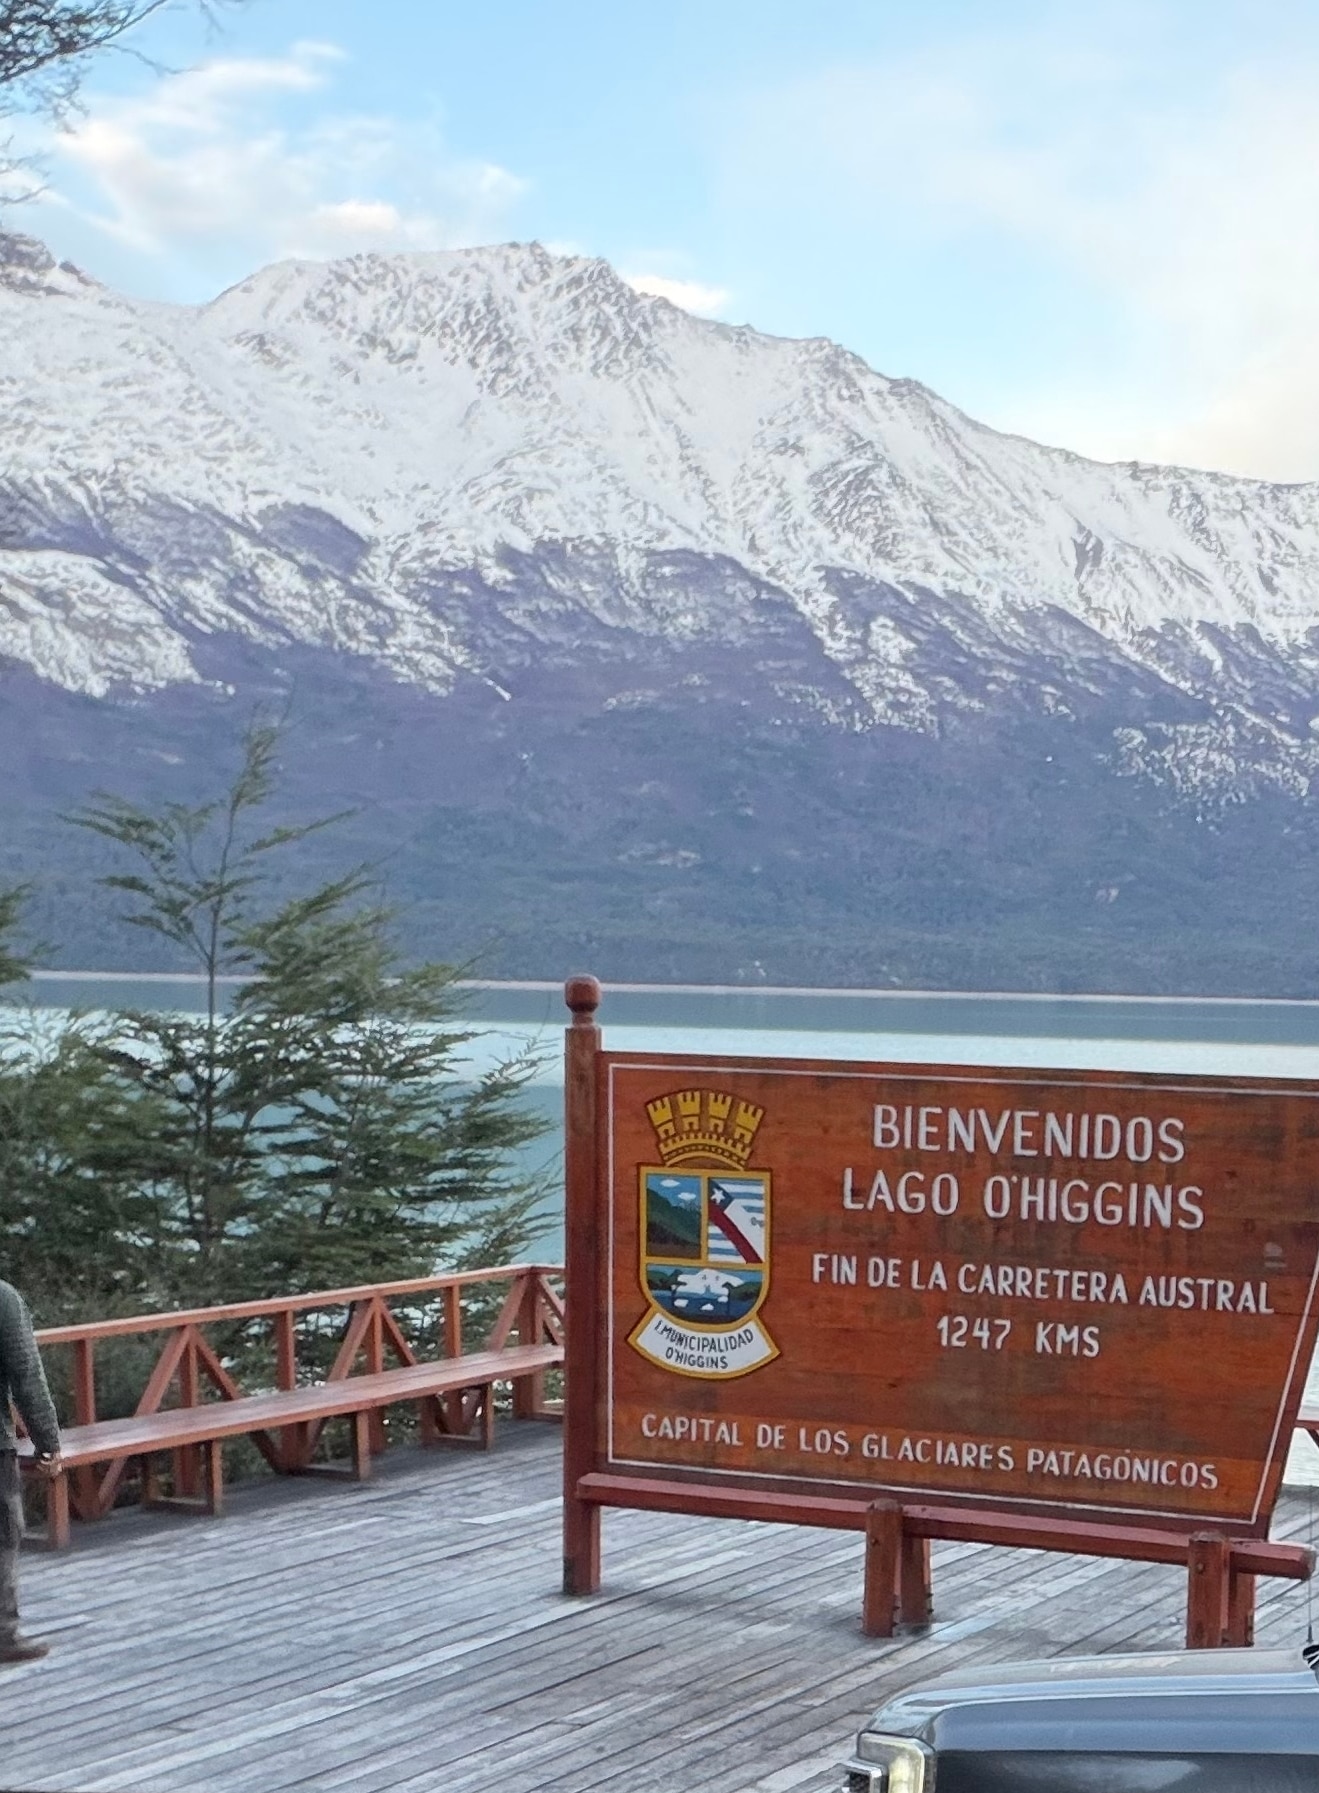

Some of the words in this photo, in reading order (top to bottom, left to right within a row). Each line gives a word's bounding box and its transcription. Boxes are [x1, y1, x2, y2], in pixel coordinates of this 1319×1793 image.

[872, 1103, 1186, 1164] BIENVENIDOS
[842, 1167, 959, 1217] LAGO
[983, 1174, 1205, 1230] O'HIGGINS
[812, 1253, 858, 1286] FIN
[867, 1257, 902, 1289] DE
[911, 1260, 948, 1292] LA
[957, 1263, 1129, 1305] CARRETERA
[1138, 1275, 1276, 1315] AUSTRAL
[665, 1347, 729, 1370] O'HIGGINS
[936, 1314, 1012, 1351] 1247
[1034, 1321, 1100, 1359] KMS
[641, 1413, 744, 1447] CAPITAL
[756, 1423, 787, 1450] DE
[799, 1427, 850, 1456] LOS
[862, 1432, 1015, 1473] GLACIARES
